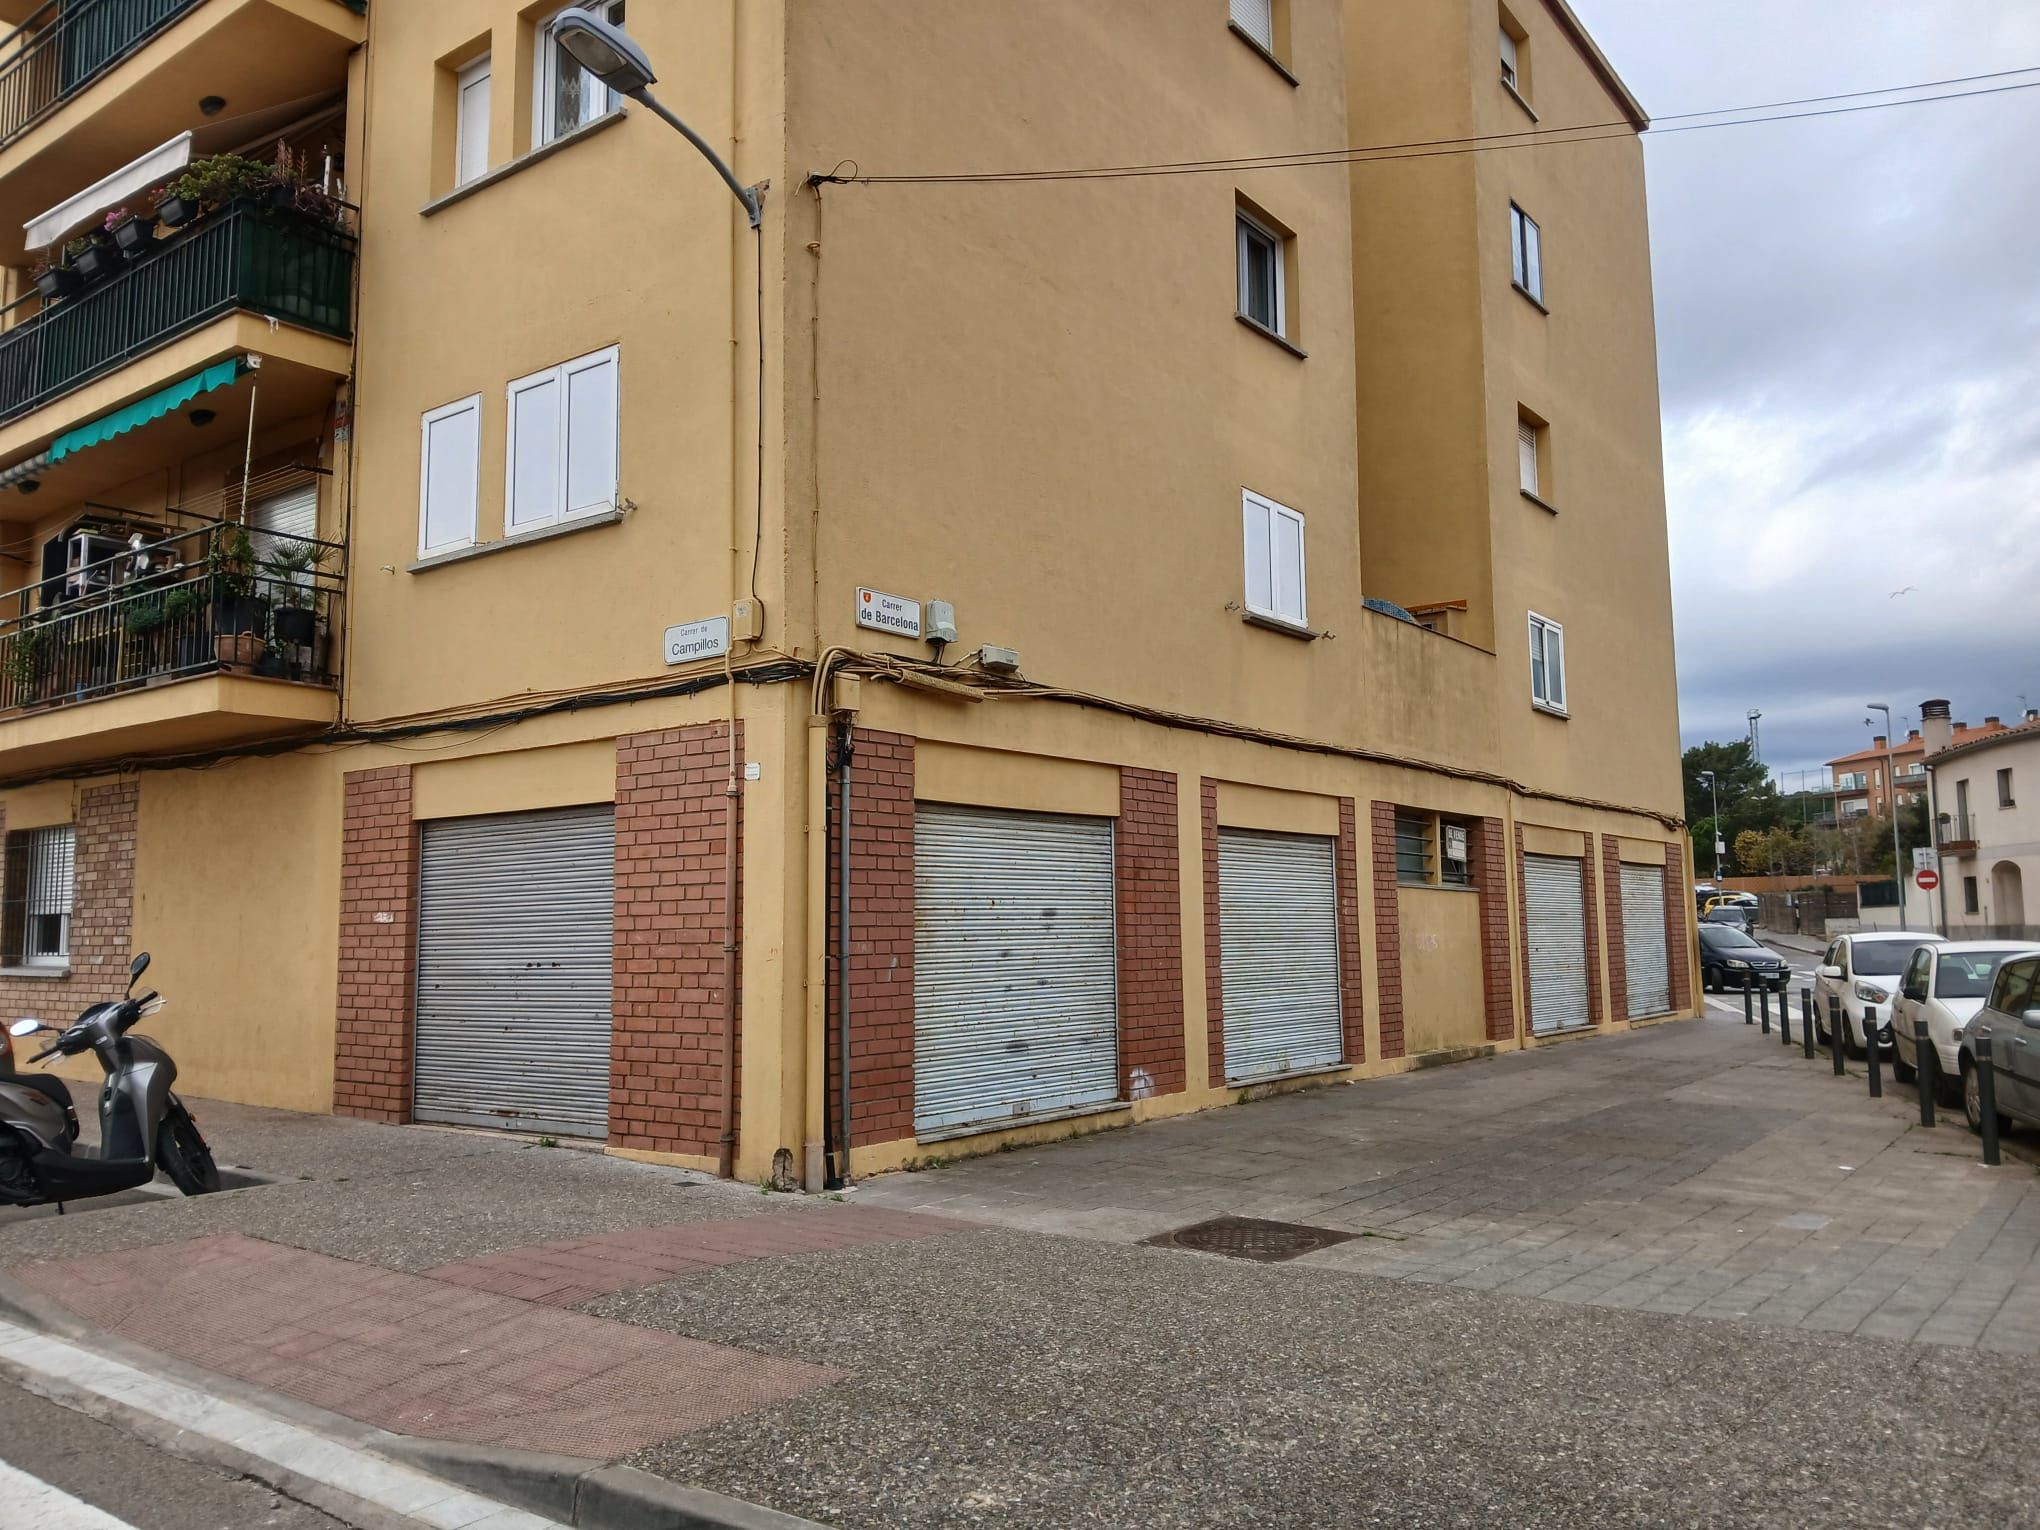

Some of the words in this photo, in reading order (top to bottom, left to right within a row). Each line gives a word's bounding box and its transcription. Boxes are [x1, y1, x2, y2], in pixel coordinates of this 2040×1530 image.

[882, 599, 902, 611] Carrer
[861, 608, 872, 620] de
[876, 610, 918, 631] Barcelona
[681, 628, 697, 637] Carrer
[701, 625, 707, 633] de
[672, 638, 719, 656] Campillos
[1453, 830, 1465, 841] VENDE
